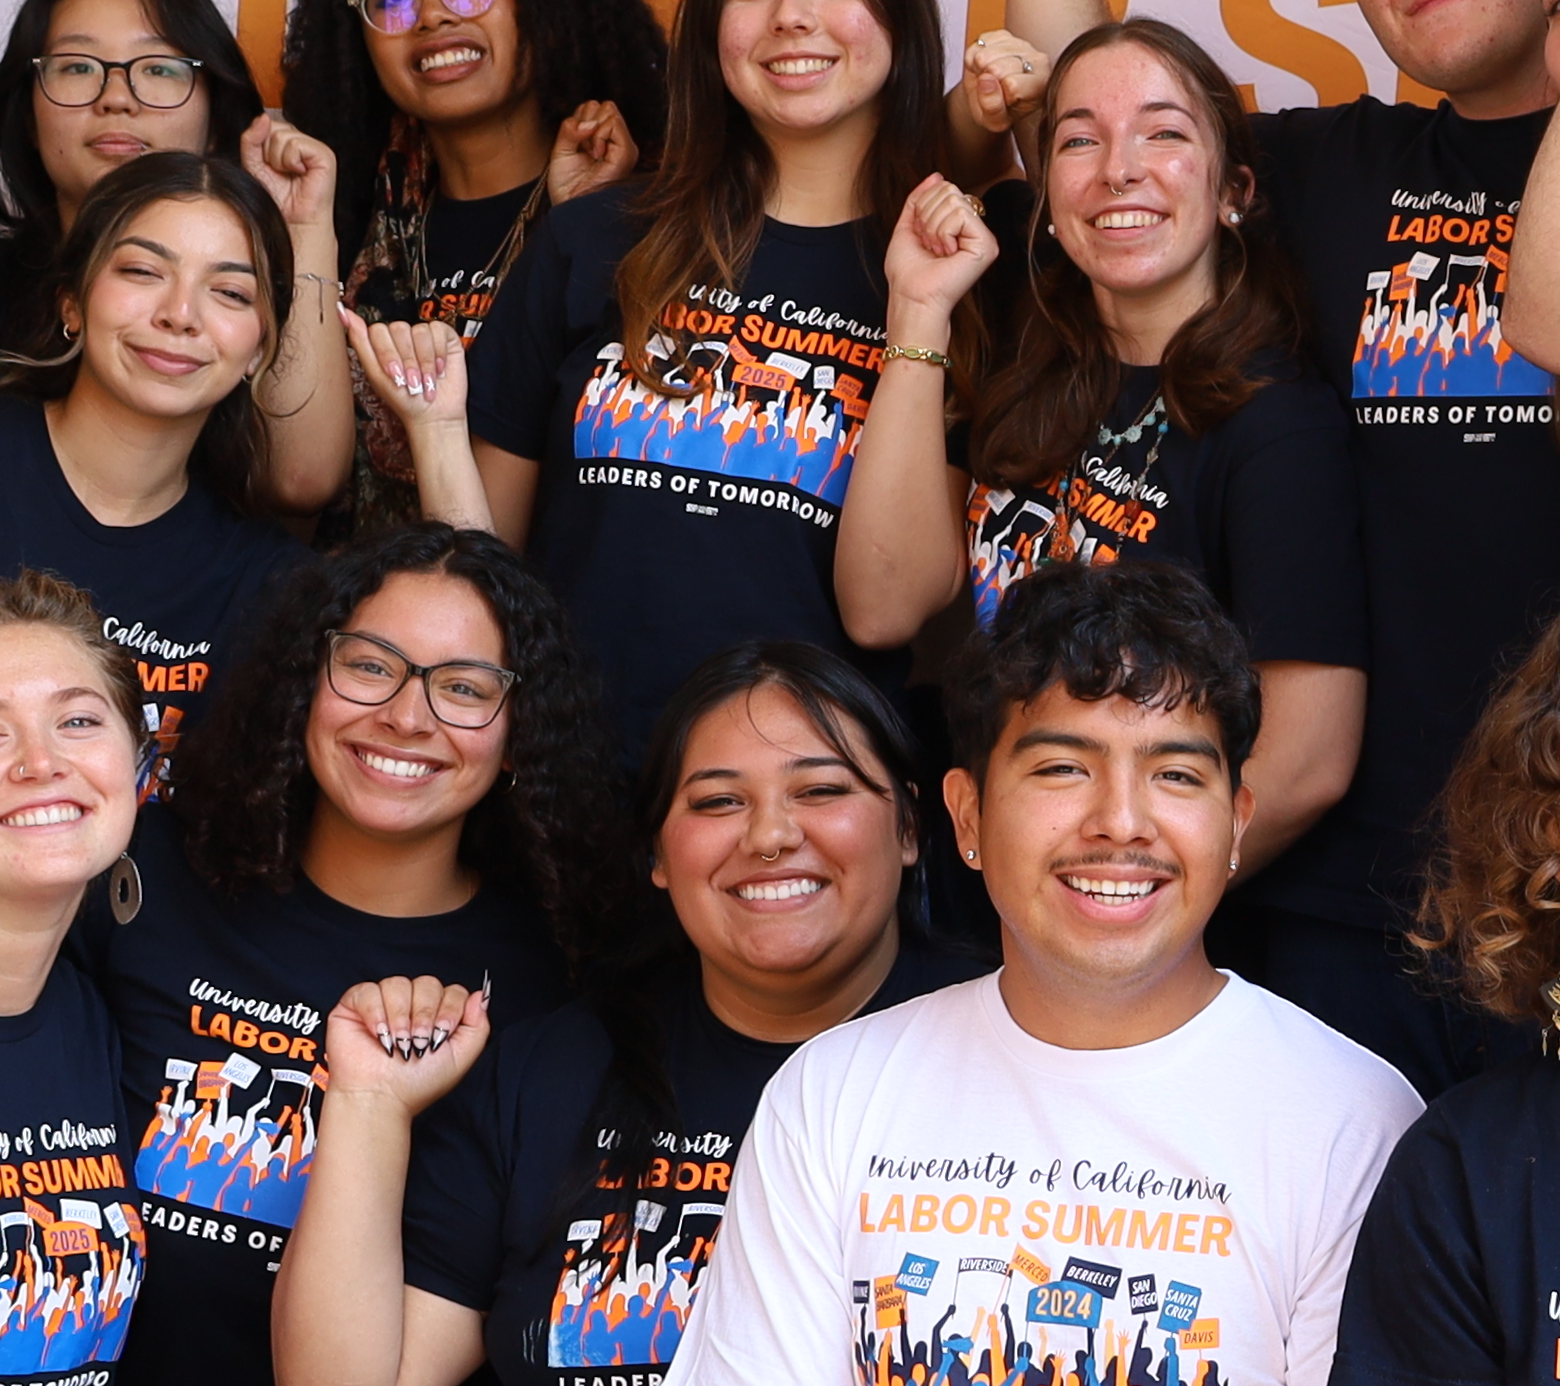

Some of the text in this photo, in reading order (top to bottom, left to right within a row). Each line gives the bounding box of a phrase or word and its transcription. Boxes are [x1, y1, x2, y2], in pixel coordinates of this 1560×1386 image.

[1387, 214, 1491, 246] LABOR
[441, 269, 465, 289] of
[747, 294, 775, 313] of
[662, 301, 886, 373] BOR SUMMER
[740, 365, 787, 390] 2025
[1356, 406, 1440, 424] LEADERS
[1448, 406, 1477, 424] OF
[578, 466, 662, 490] LEADERS
[670, 474, 700, 495] OF
[103, 616, 212, 660] California
[189, 977, 321, 1036] University
[191, 1004, 318, 1062] LABOR
[14, 1126, 35, 1155] of
[40, 1119, 117, 1151] Californi
[21, 1154, 127, 1197] SUMM
[1029, 1158, 1062, 1192] of
[1072, 1159, 1233, 1205] California
[141, 1201, 283, 1253] EADERS OF
[859, 1192, 1234, 1257] LABOR SUMMER
[50, 1228, 91, 1253] 2025
[907, 1261, 926, 1275] LOS
[960, 1258, 1007, 1273] RIVERSIDE
[1015, 1254, 1048, 1283] MERCED
[1066, 1265, 1118, 1288] BERKELEY
[896, 1274, 931, 1290] ANGELES
[1132, 1278, 1151, 1294] SAN
[1034, 1287, 1093, 1320] 2024
[1131, 1292, 1158, 1309] DIEGO
[1165, 1288, 1198, 1308] SANTA
[1164, 1304, 1193, 1322] CRUZ
[1184, 1331, 1214, 1344] DAVIS
